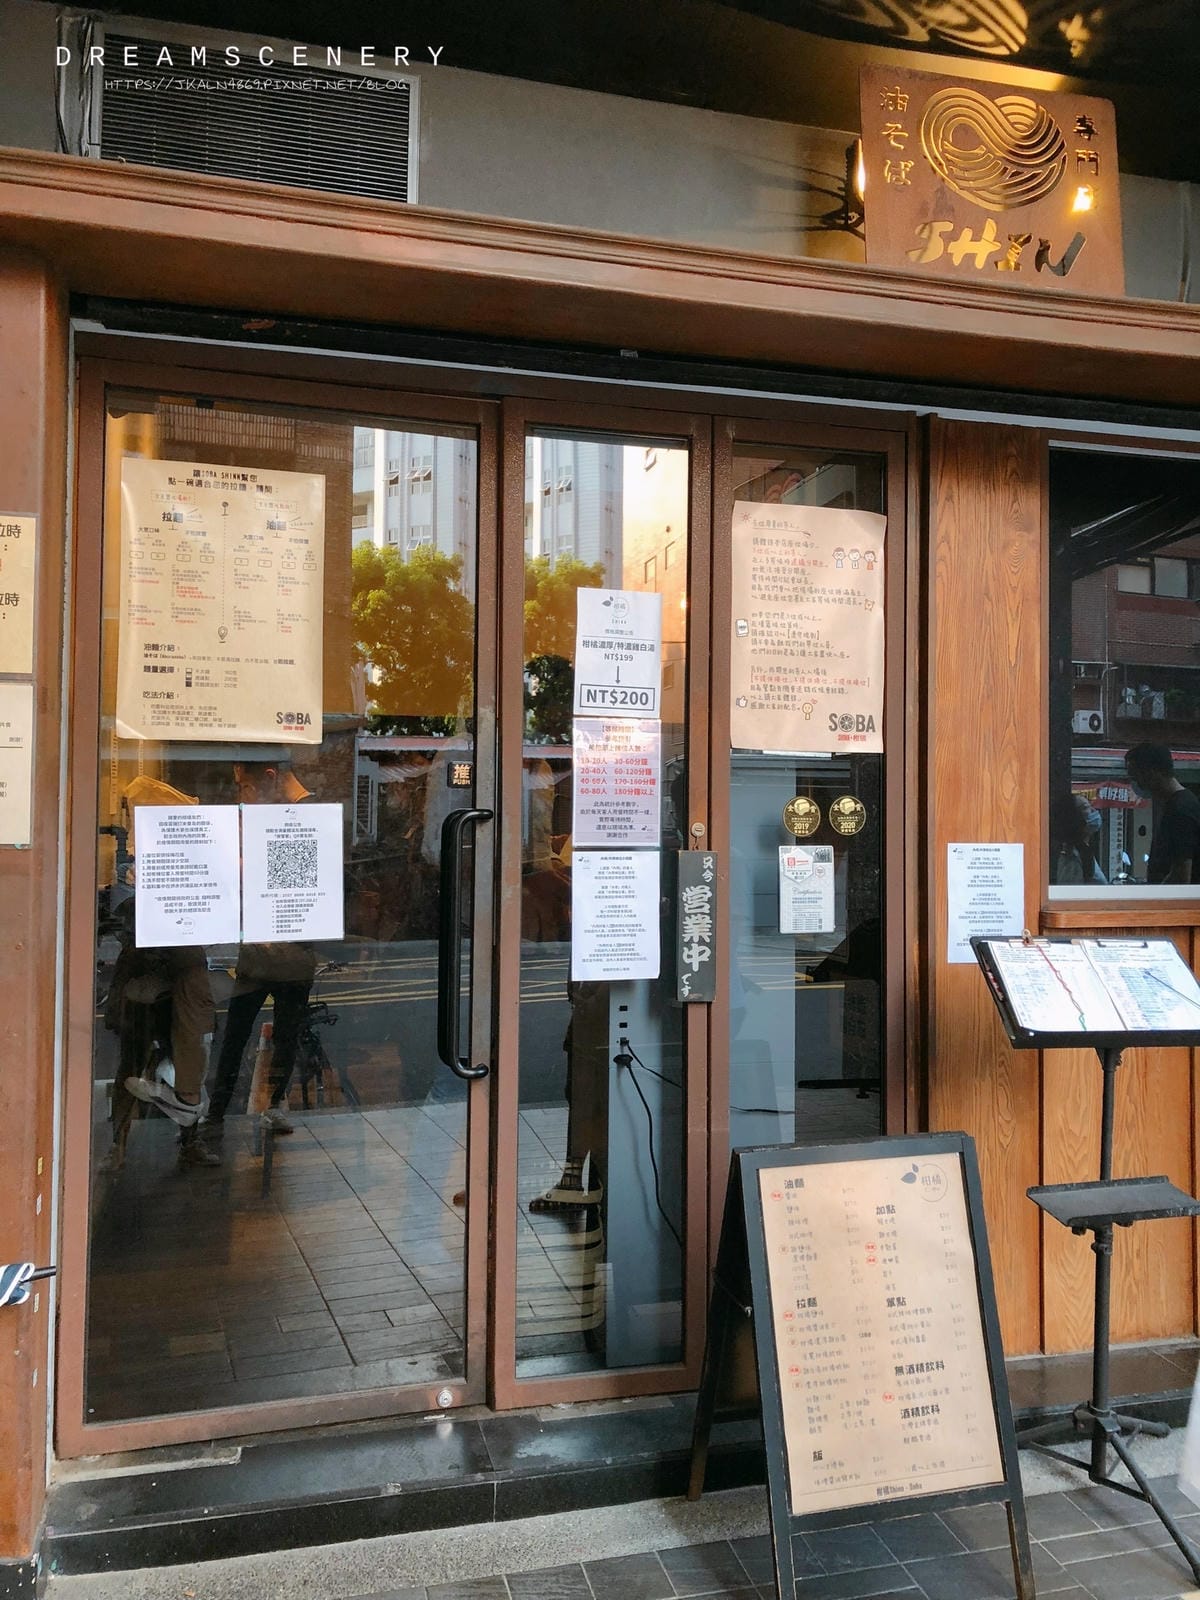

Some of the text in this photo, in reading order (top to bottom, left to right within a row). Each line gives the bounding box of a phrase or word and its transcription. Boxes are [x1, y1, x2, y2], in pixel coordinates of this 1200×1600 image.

[879, 86, 915, 186] 油そば
[604, 653, 634, 661] NT$199
[586, 689, 649, 706] NT$200
[828, 713, 876, 733] SOBA
[453, 764, 471, 779] 推
[794, 822, 809, 830] 2019
[682, 884, 713, 972] 営業中
[784, 1178, 805, 1190] 油麵
[875, 1205, 896, 1215] 加點
[796, 1297, 817, 1309] 拉麵
[886, 1297, 906, 1308] 單點
[895, 1360, 945, 1376] 無酒精飲料
[900, 1404, 941, 1419] 酒精飲料
[813, 1450, 823, 1462] 飯
